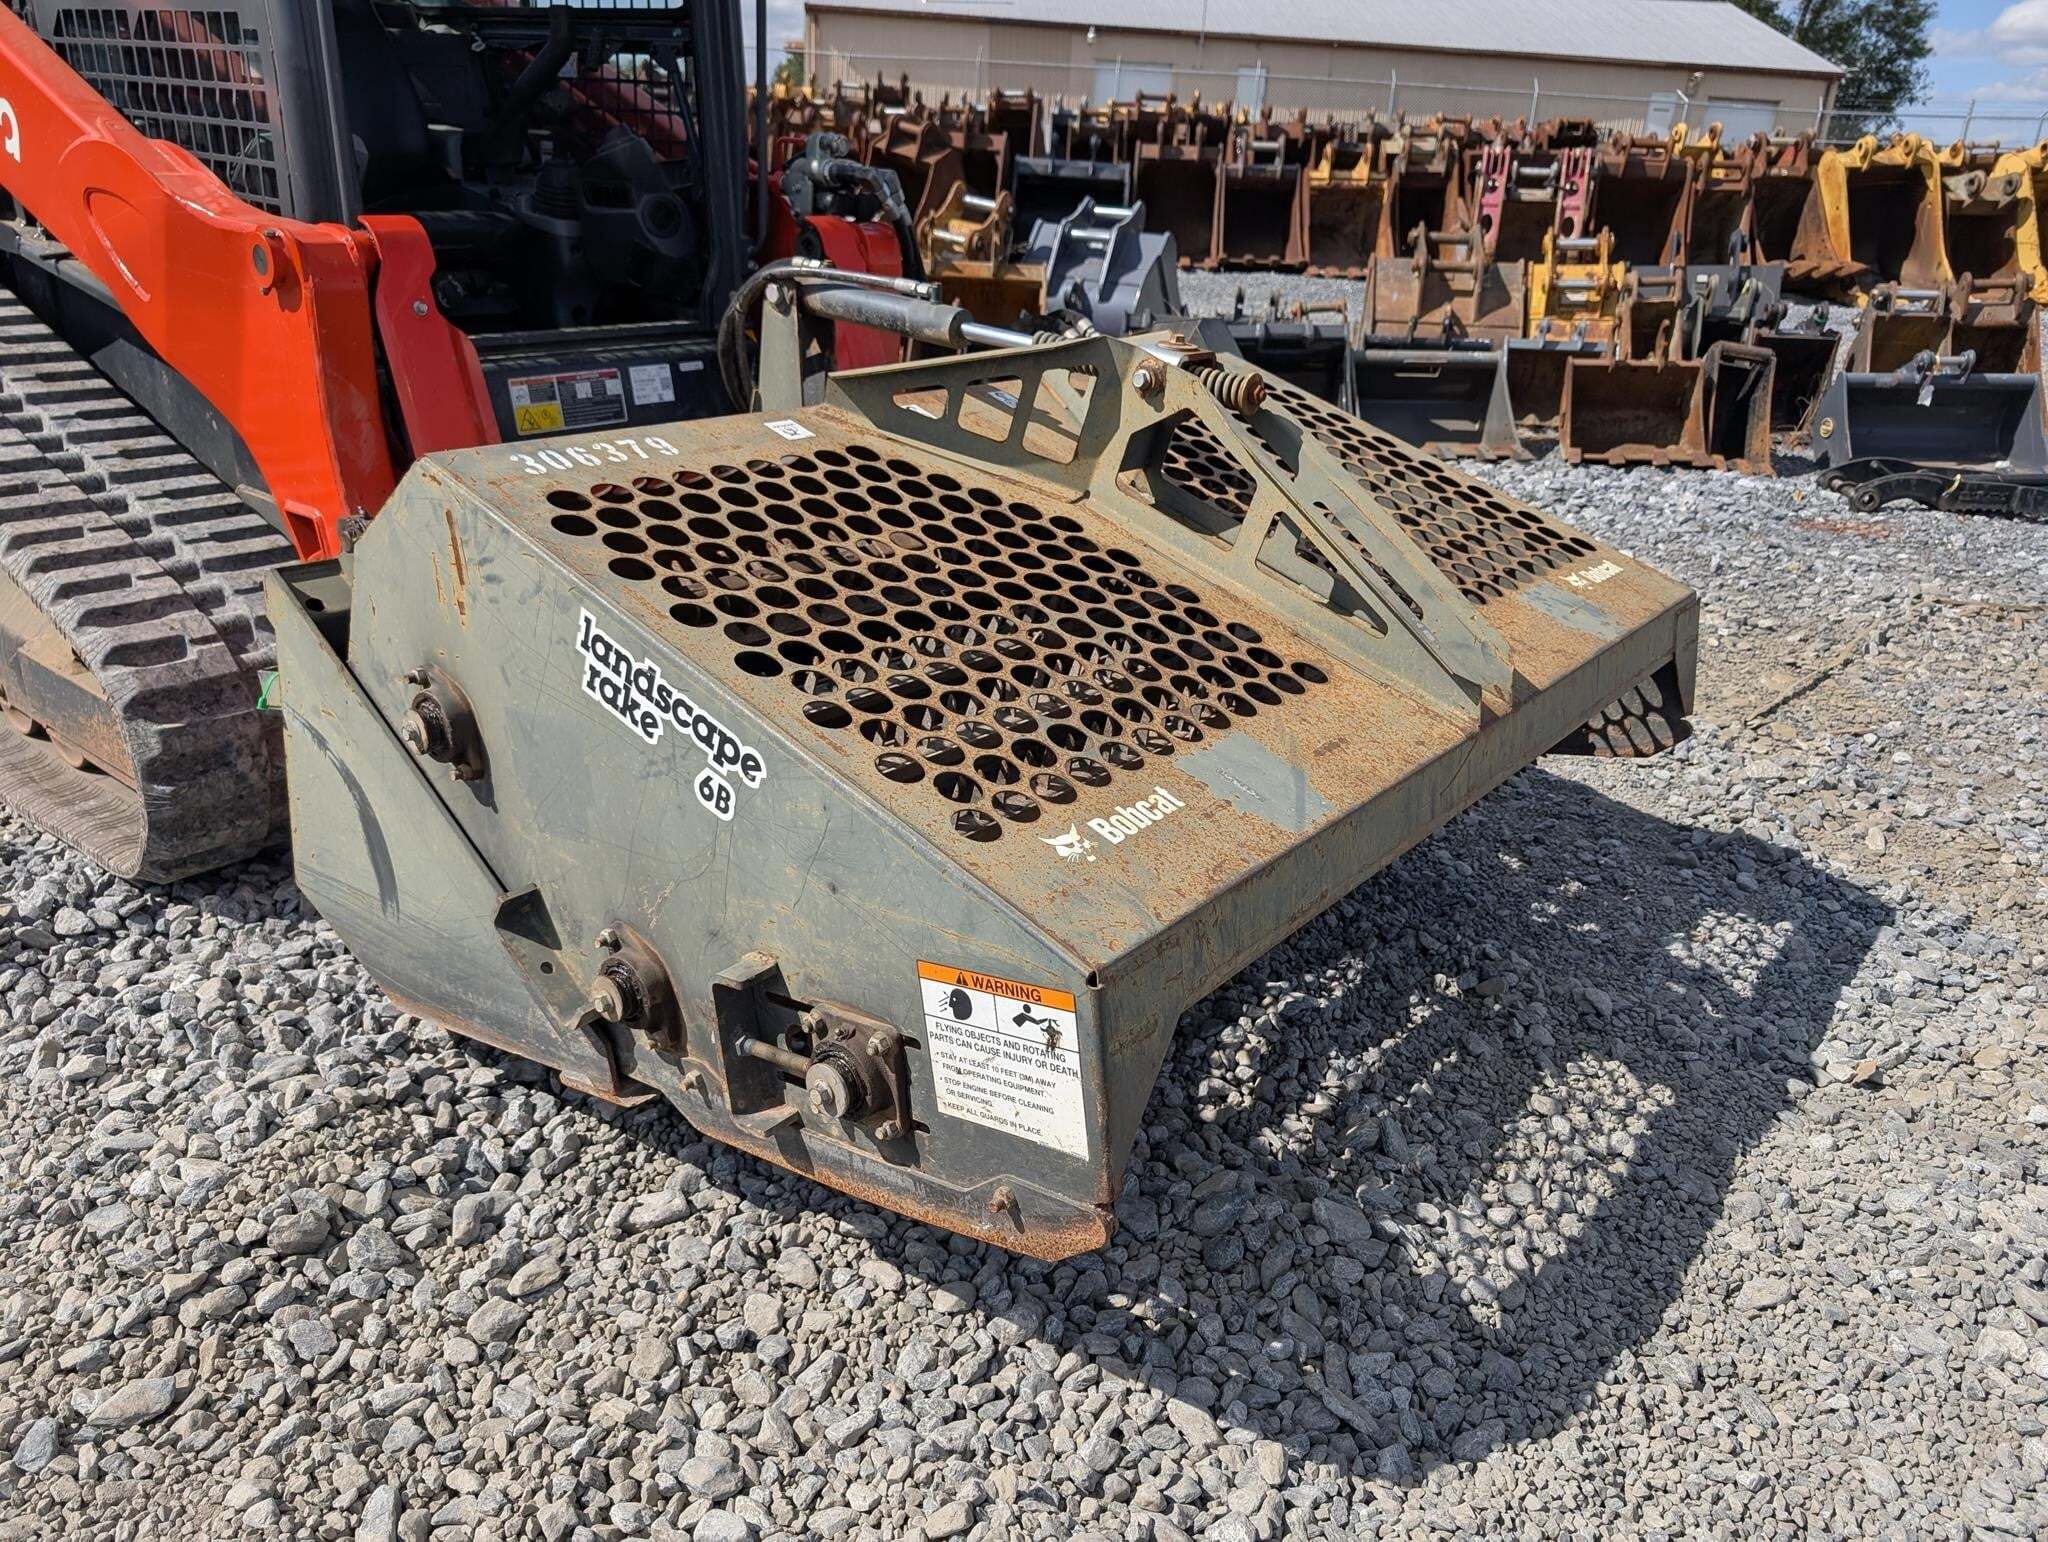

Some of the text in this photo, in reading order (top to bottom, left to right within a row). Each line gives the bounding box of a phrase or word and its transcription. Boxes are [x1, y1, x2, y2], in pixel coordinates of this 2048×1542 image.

[510, 436, 679, 476] 306379
[580, 615, 762, 783] landscape
[586, 663, 659, 739] rake
[699, 775, 731, 814] 6B
[1087, 786, 1186, 845] Bobcat
[971, 974, 1042, 1003] WARNING
[930, 1031, 954, 1045] PARTS
[956, 1038, 972, 1049] CAN
[974, 1043, 1001, 1057] CAUSE
[1003, 1051, 1032, 1066] INJURY
[1035, 1059, 1047, 1069] OR
[935, 1021, 1066, 1063] FLYING OBJECTS AND ROTATING
[940, 1051, 957, 1061] STAY
[958, 1056, 968, 1064] AT
[968, 1059, 990, 1070] LEAST
[991, 1065, 999, 1073] 10
[1000, 1067, 1017, 1078] FEET
[1035, 1078, 1056, 1089] AWAY
[962, 1068, 1002, 1085] OPERATING
[944, 1077, 1055, 1115] STOP ENGINE BEFORE CLEANING
[945, 1088, 956, 1096] OR
[947, 1102, 965, 1111] KEEP
[966, 1108, 978, 1116] ALL
[980, 1111, 1008, 1126] GUARDS
[1009, 1120, 1017, 1128] IN
